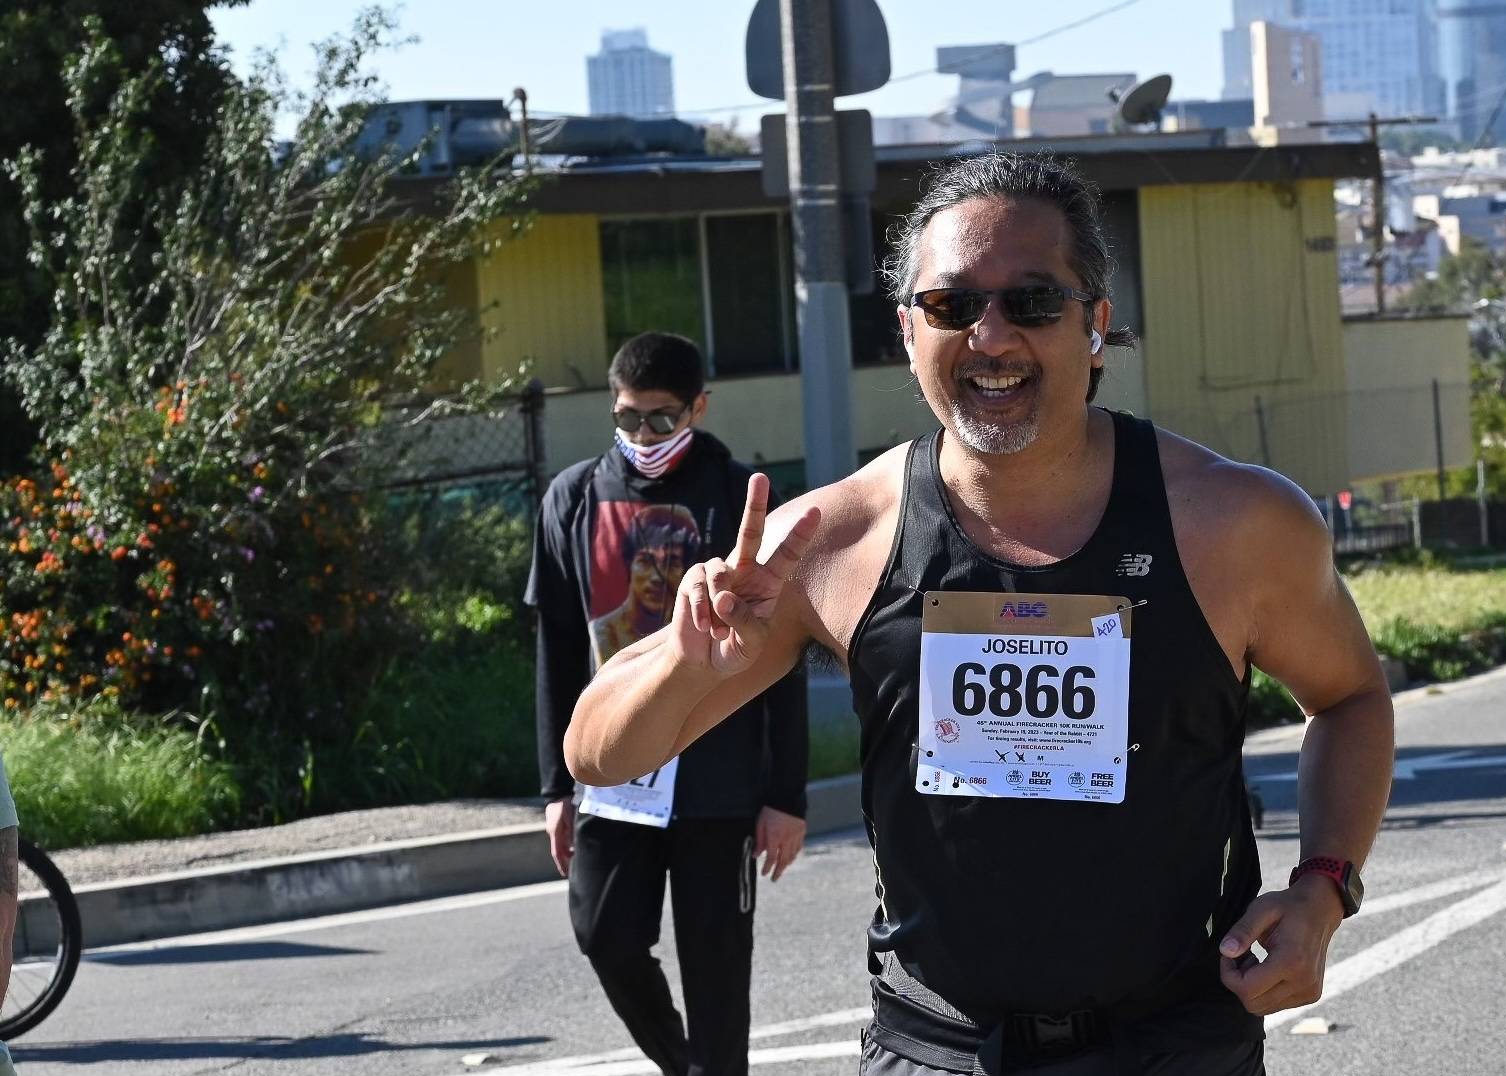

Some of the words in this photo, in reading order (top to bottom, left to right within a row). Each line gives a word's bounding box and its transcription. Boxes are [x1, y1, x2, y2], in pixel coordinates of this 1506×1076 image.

[1000, 601, 1048, 617] ABC
[1096, 618, 1117, 637] 420
[982, 638, 1069, 655] JOSELITO
[952, 662, 1096, 719] 6866
[1016, 721, 1058, 729] FIRECRACKER
[1031, 770, 1051, 779] BUY
[1091, 772, 1114, 780] FREE
[969, 777, 987, 785] 6866
[1028, 778, 1052, 786] BEER
[1090, 780, 1114, 788] BEER
